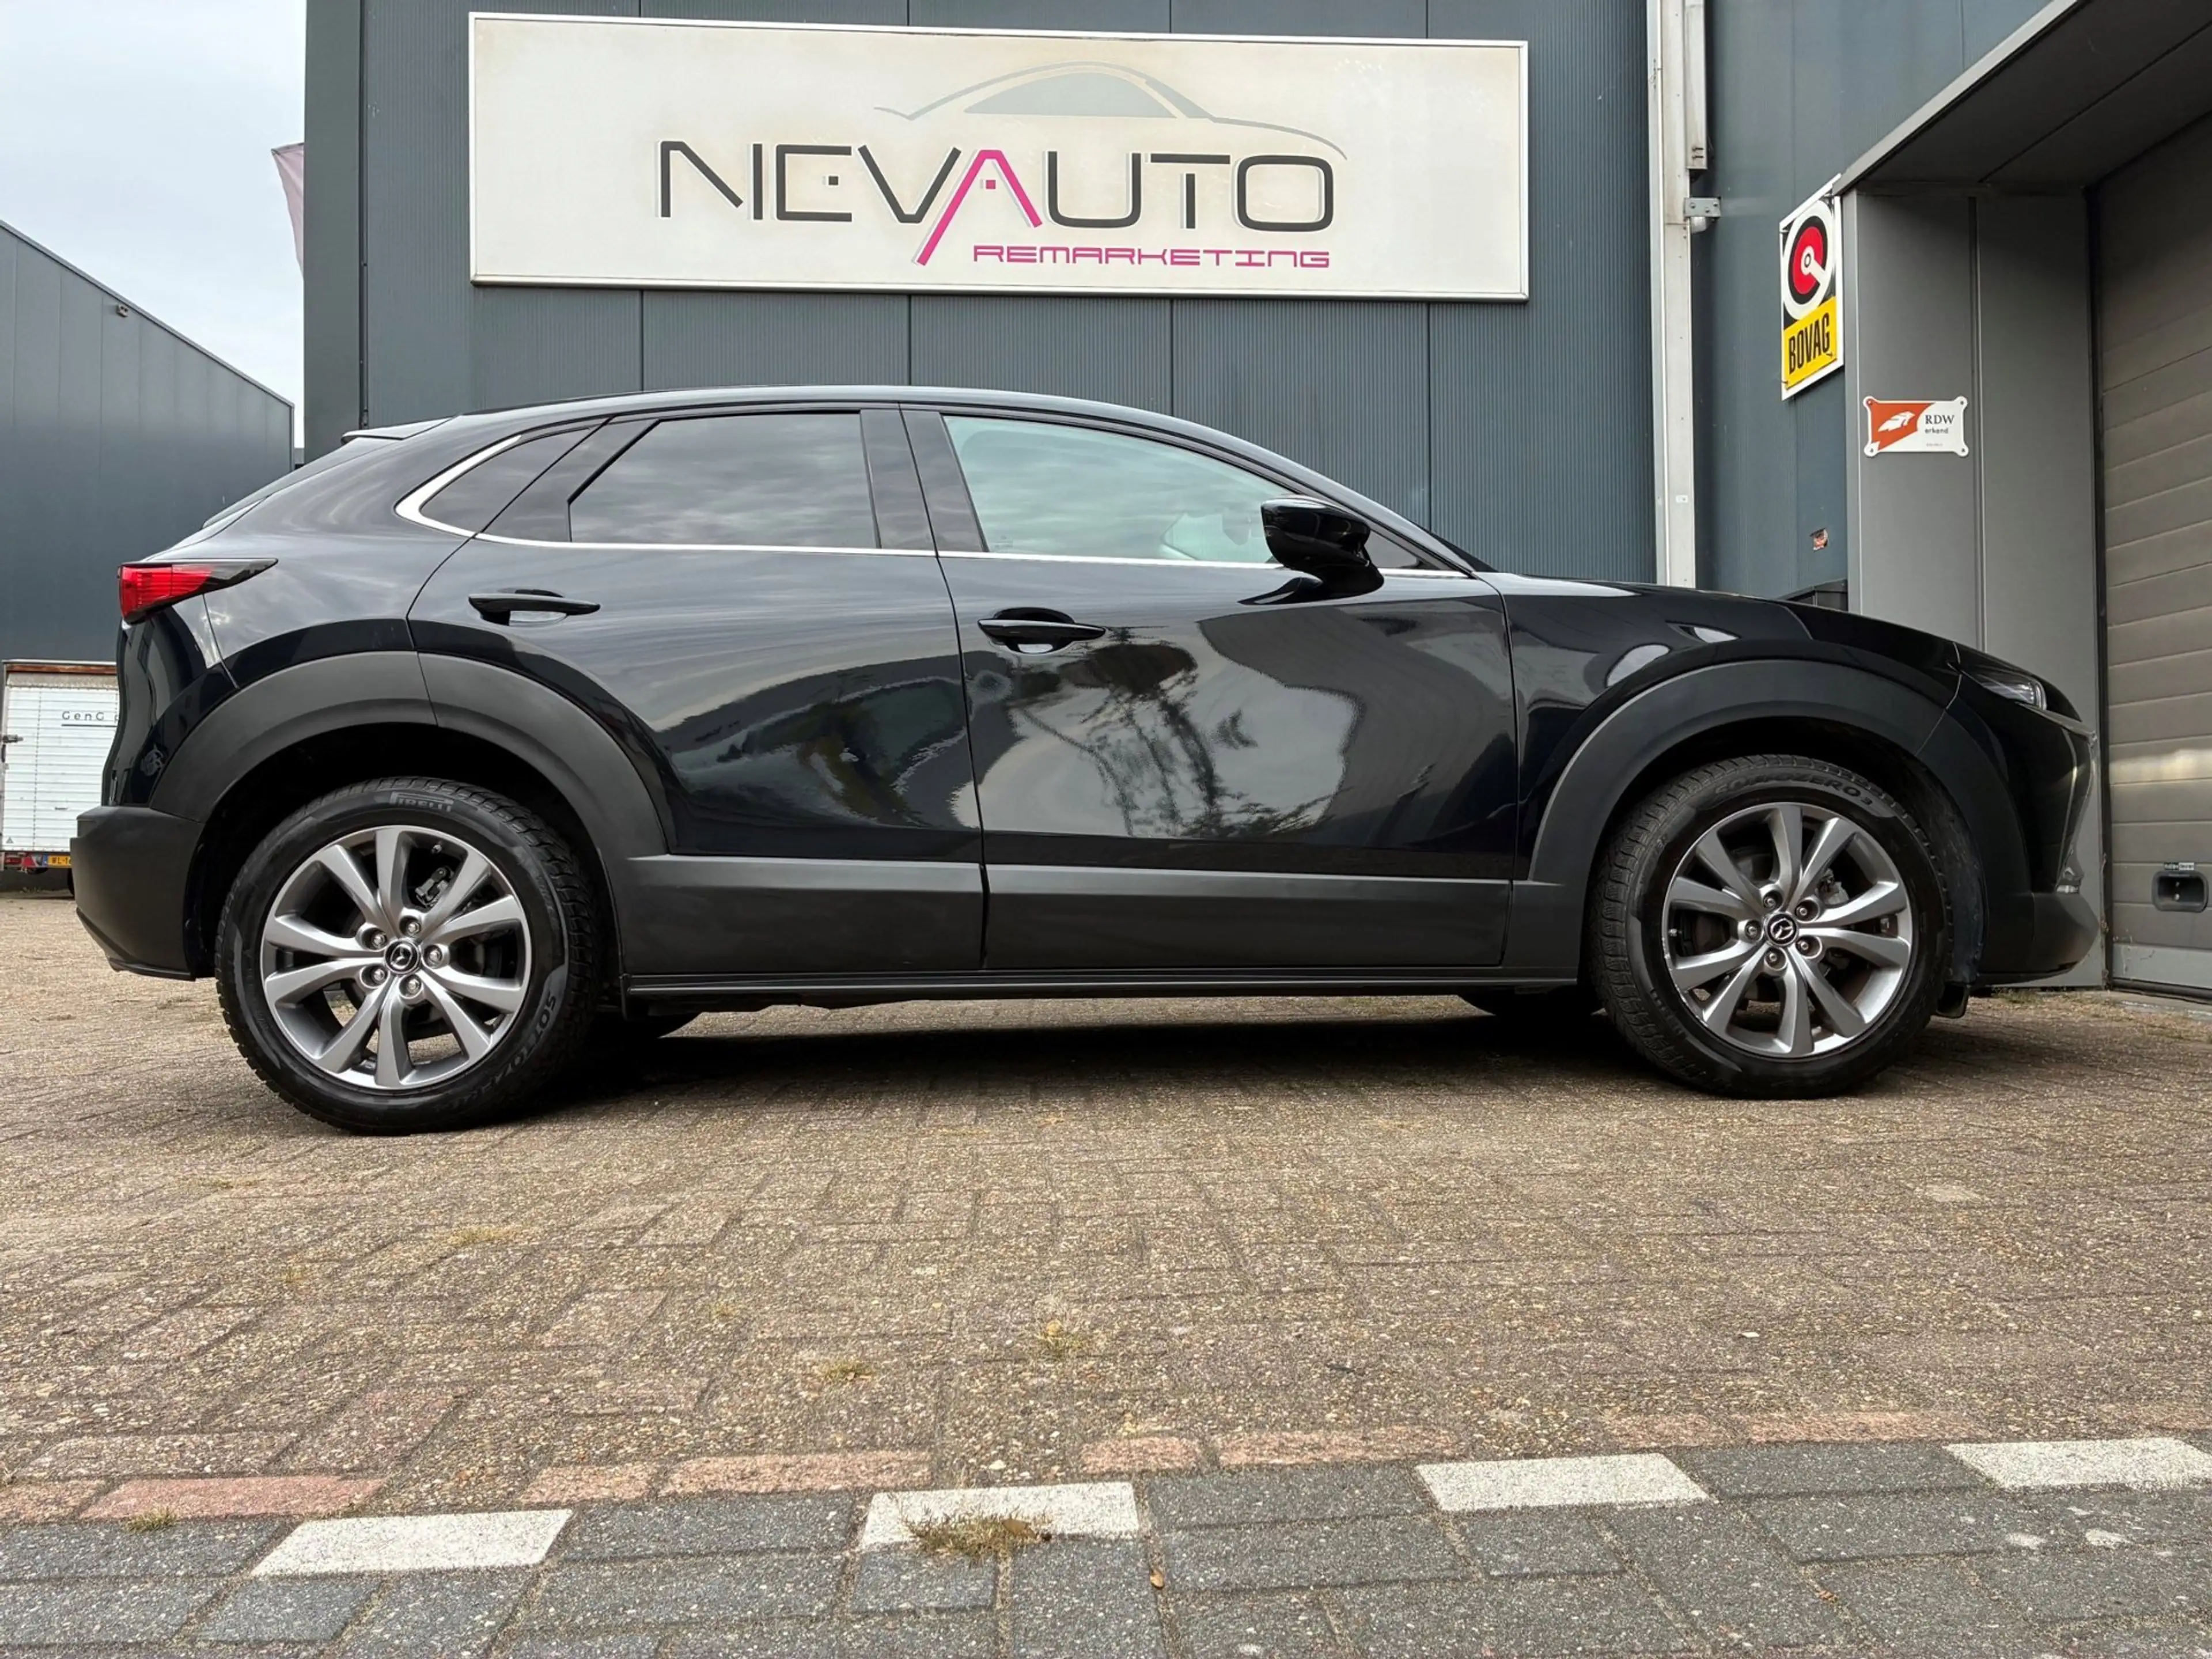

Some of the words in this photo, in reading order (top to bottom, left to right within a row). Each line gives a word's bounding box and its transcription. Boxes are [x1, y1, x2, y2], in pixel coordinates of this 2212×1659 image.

[661, 141, 1333, 266] NEVAUTO
[974, 245, 1330, 268] REMARKETING
[1789, 313, 1830, 374] BOVAG
[1925, 414, 1955, 425] RDW
